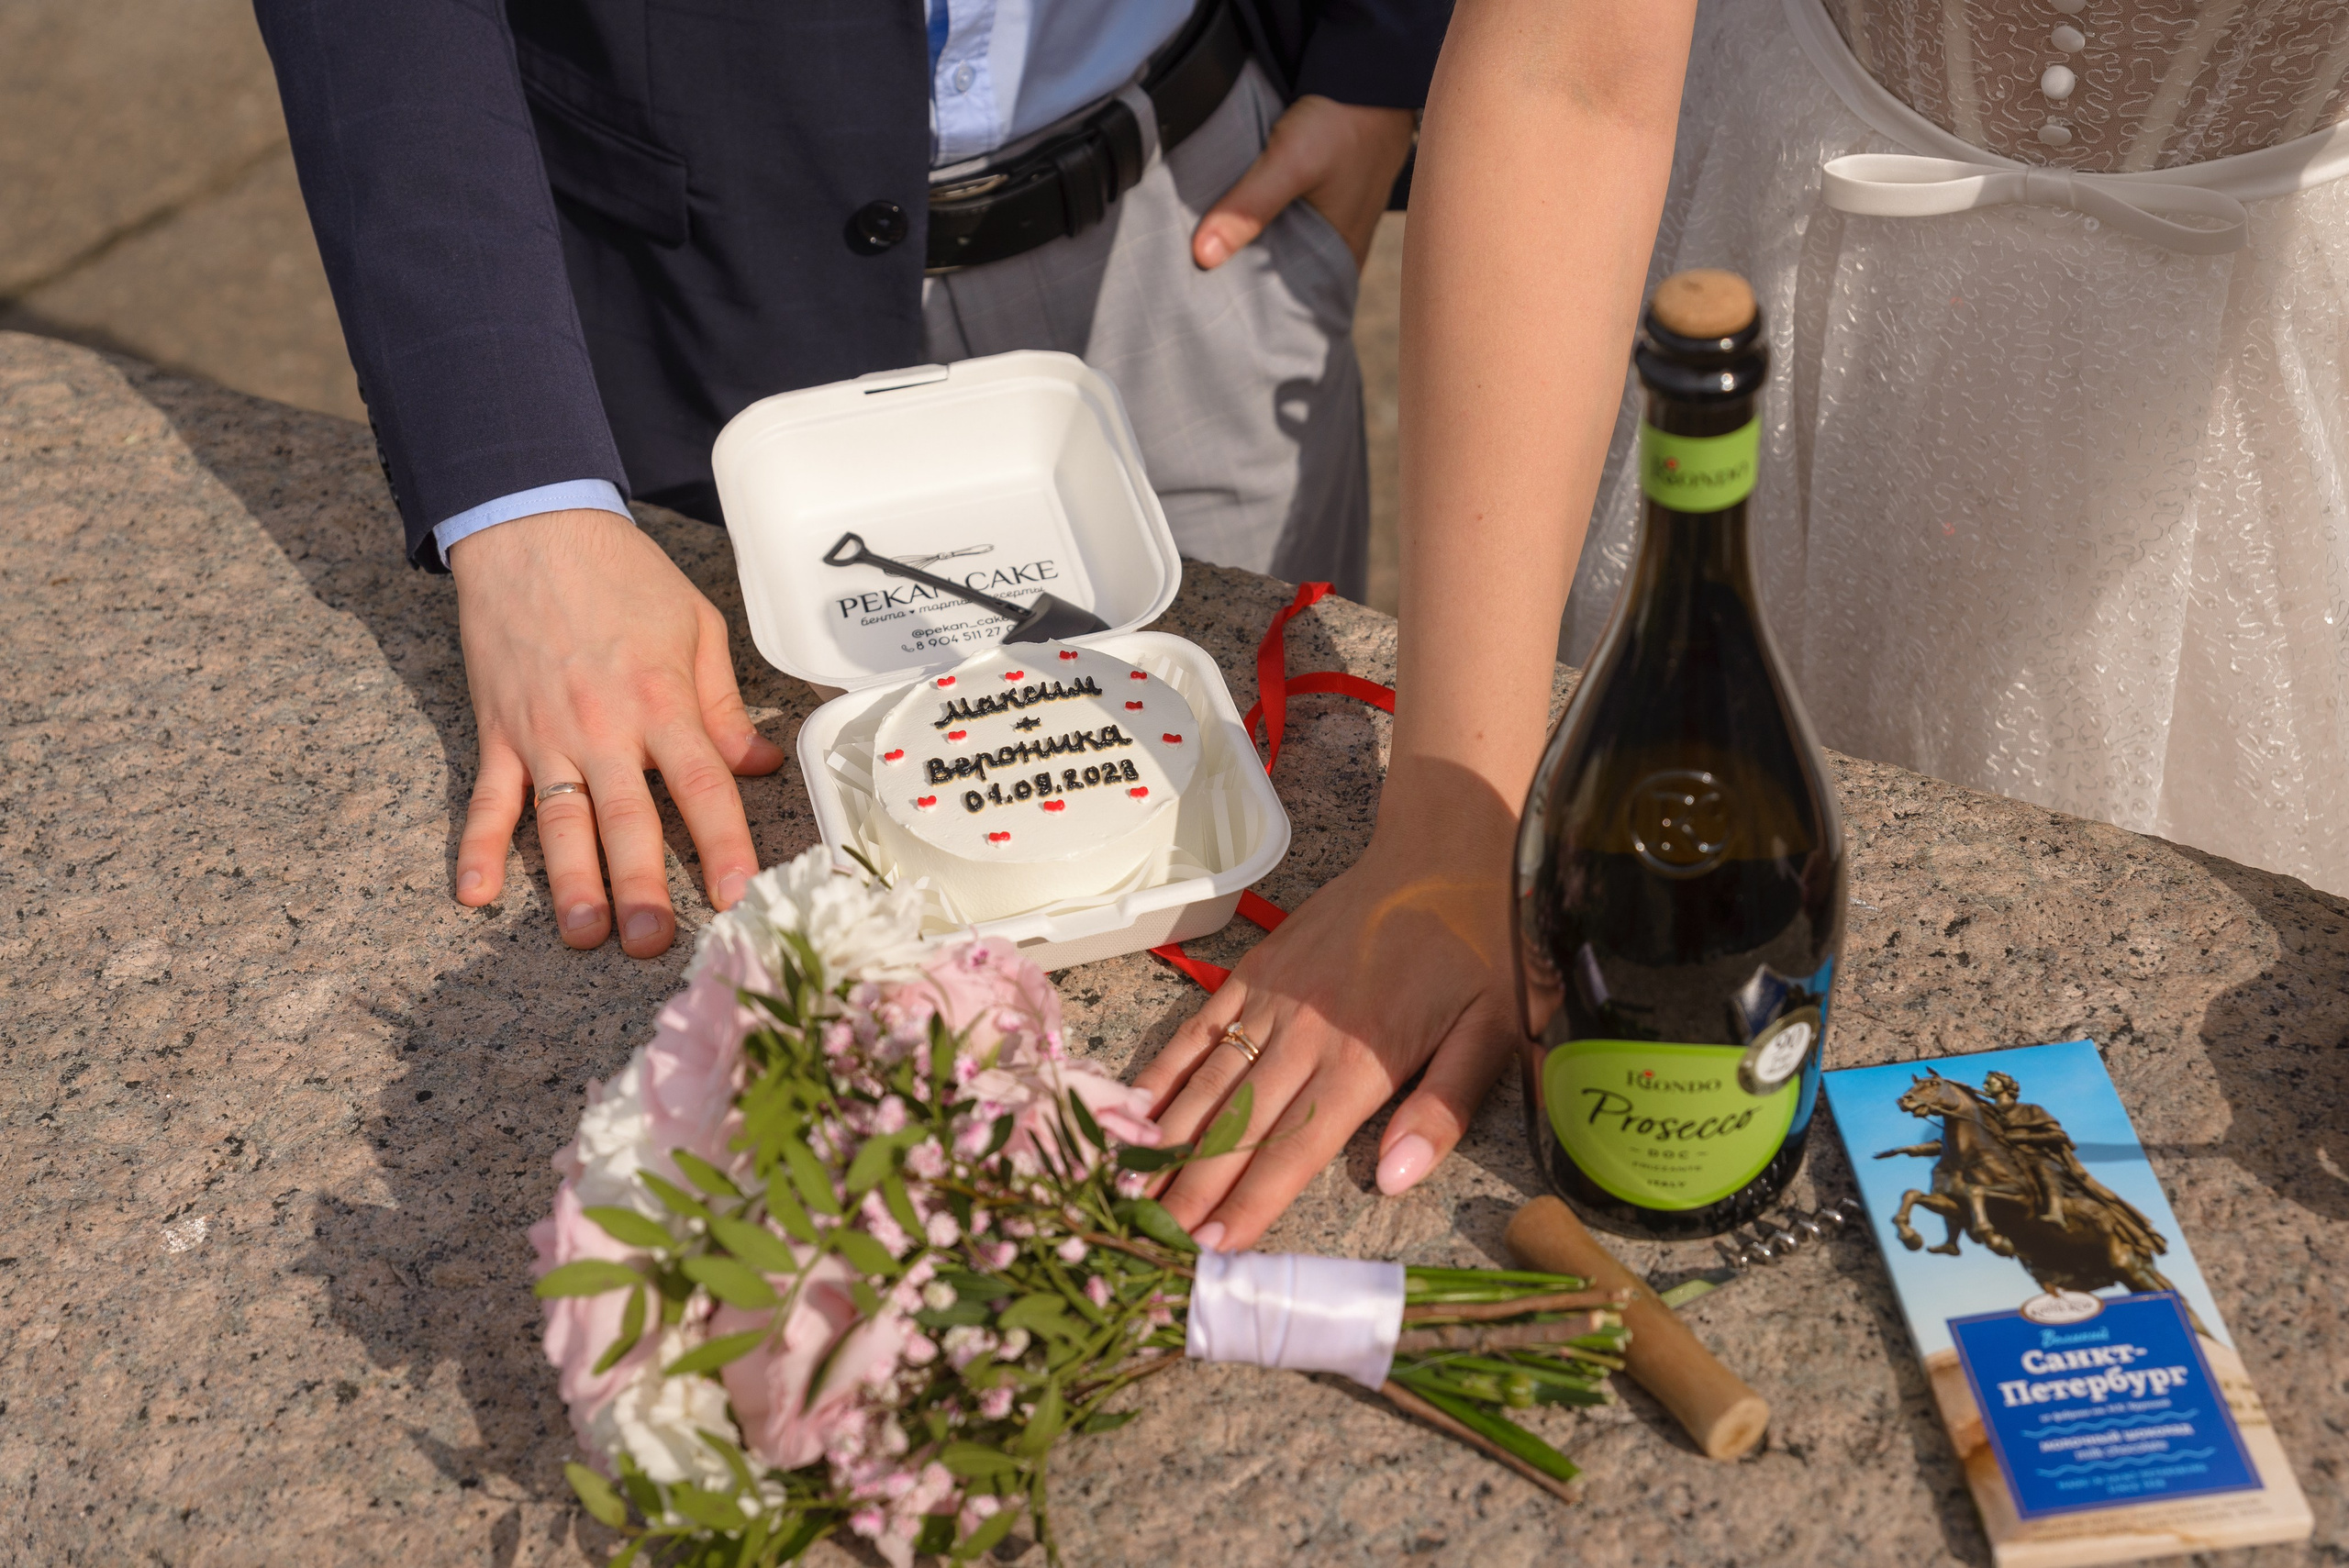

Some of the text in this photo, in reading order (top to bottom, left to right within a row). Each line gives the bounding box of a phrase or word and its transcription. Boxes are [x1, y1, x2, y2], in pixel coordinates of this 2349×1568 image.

[964, 560, 1059, 593] CAKE
[860, 609, 907, 626] бента
[988, 585, 1045, 601] есерты
[917, 640, 925, 651] 8
[929, 635, 959, 648] 904
[963, 629, 983, 641] 511
[985, 626, 1001, 639] 27
[933, 675, 1103, 730] Максим
[926, 724, 1134, 787] Вероника
[963, 758, 1141, 815] 01.09.2023
[1582, 1088, 1762, 1141] Prosecco
[2021, 1343, 2148, 1375] Санкт-
[1998, 1365, 2189, 1407] Петербург
